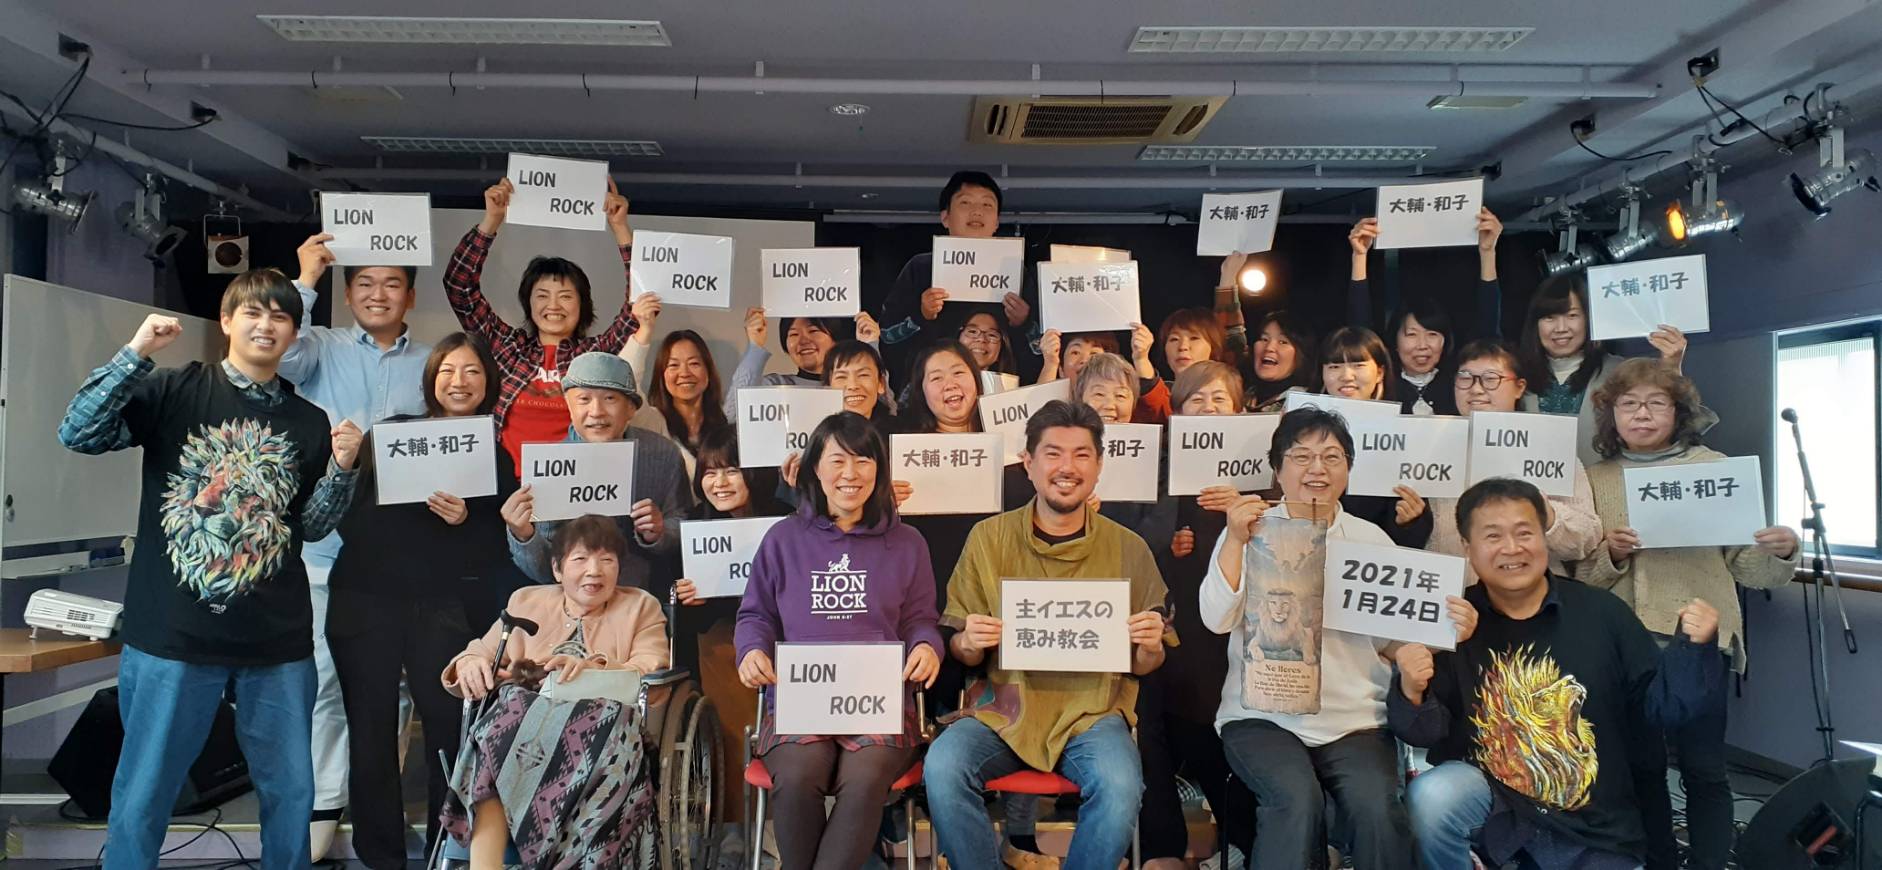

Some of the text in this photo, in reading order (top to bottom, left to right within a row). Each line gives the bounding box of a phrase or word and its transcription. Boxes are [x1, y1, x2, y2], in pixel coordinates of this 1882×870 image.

[519, 170, 556, 188] LION
[550, 197, 595, 216] ROCK
[334, 209, 374, 225] LION
[370, 235, 418, 251] ROCK
[642, 246, 679, 264] LION
[943, 250, 976, 266] LION
[773, 262, 809, 278] LION
[672, 273, 718, 292] ROCK
[970, 274, 1010, 290] ROCK
[804, 286, 848, 303] ROCK
[749, 404, 790, 422] LION
[992, 403, 1029, 426] LION
[785, 431, 809, 450] RO
[1181, 431, 1224, 450] LION
[1362, 433, 1406, 451] LION
[1485, 429, 1528, 448] LION
[533, 459, 576, 478] LION
[1217, 458, 1263, 478] ROCK
[1400, 463, 1453, 482] ROCK
[1523, 459, 1565, 479] ROCK
[569, 484, 619, 503] ROCK
[692, 535, 732, 555] LION
[730, 561, 752, 580] RO
[1342, 559, 1440, 593] 2021年
[811, 574, 867, 592] LION
[811, 593, 867, 609] ROCK
[1015, 598, 1114, 619] 主イエスの
[1342, 589, 1440, 623] 1月24日
[1015, 627, 1100, 650] 恵み教会
[789, 663, 837, 684] LION
[829, 695, 886, 716] ROCK
